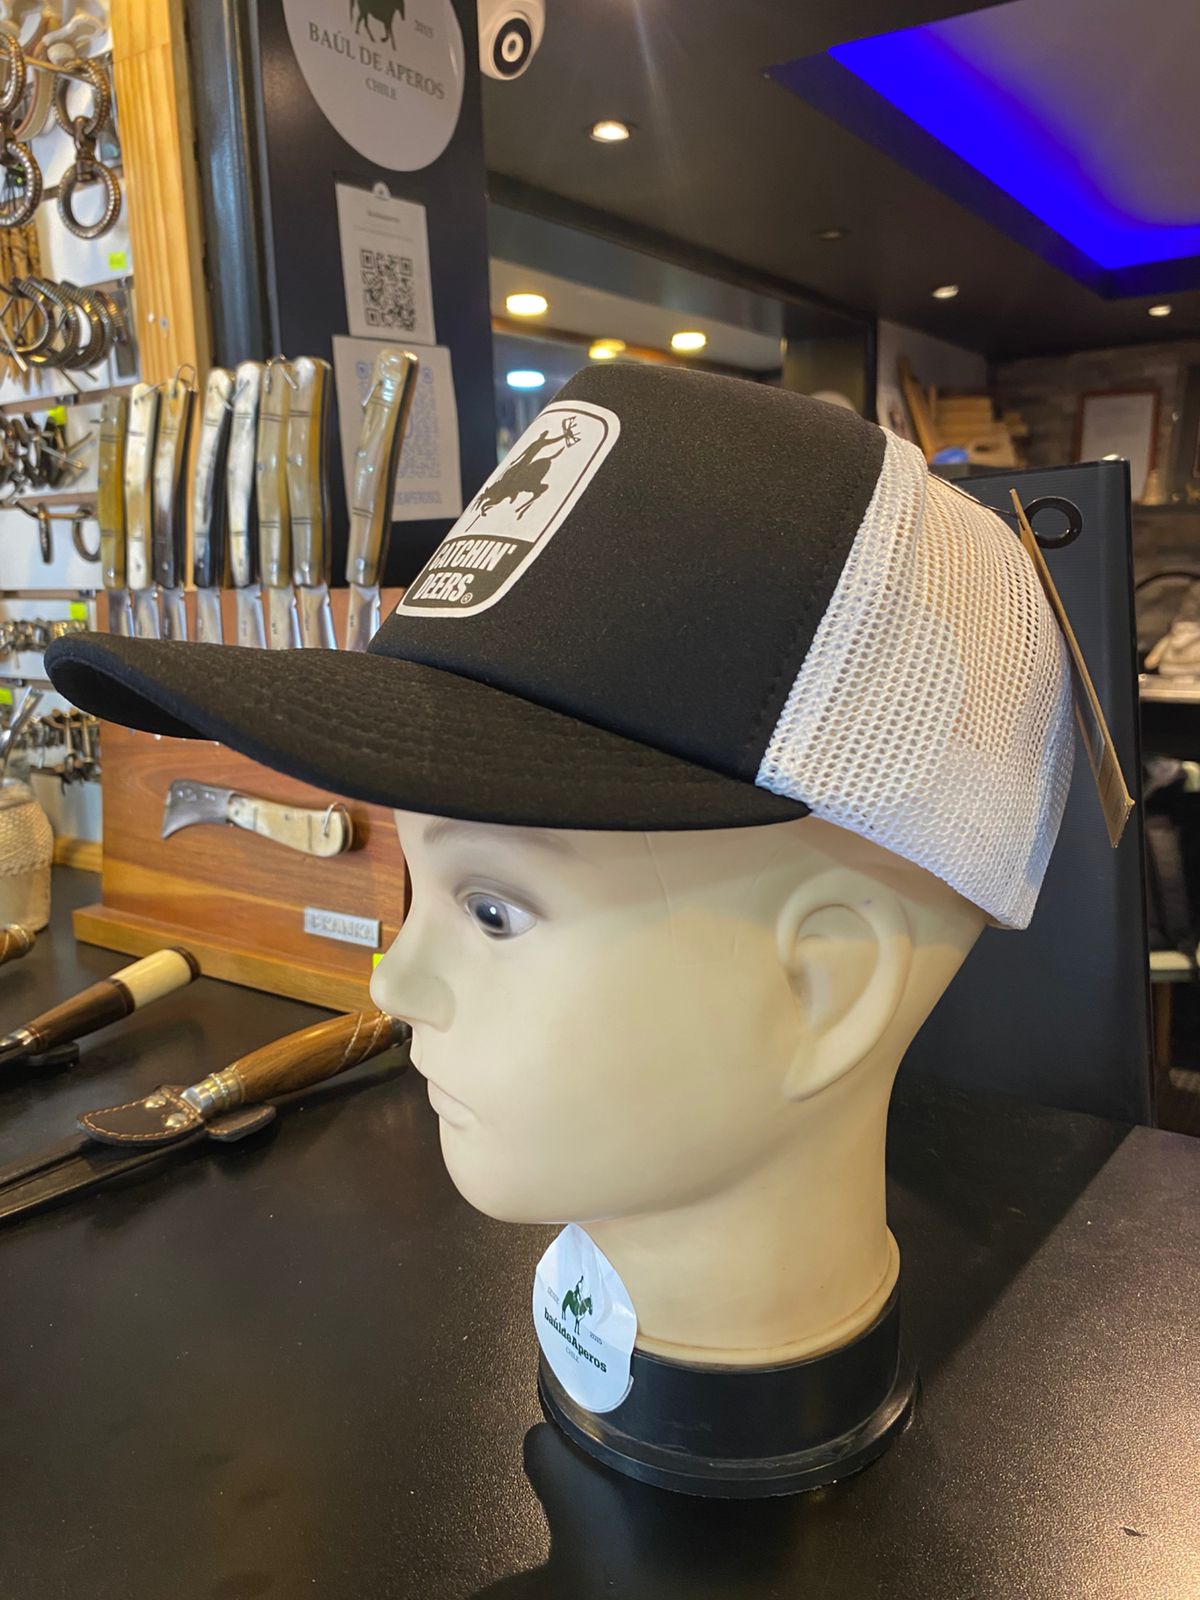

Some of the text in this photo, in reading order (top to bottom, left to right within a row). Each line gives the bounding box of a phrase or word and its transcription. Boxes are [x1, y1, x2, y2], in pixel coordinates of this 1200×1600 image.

[309, 21, 445, 100] BAÚL DE APEROS
[365, 77, 397, 100] CHILE
